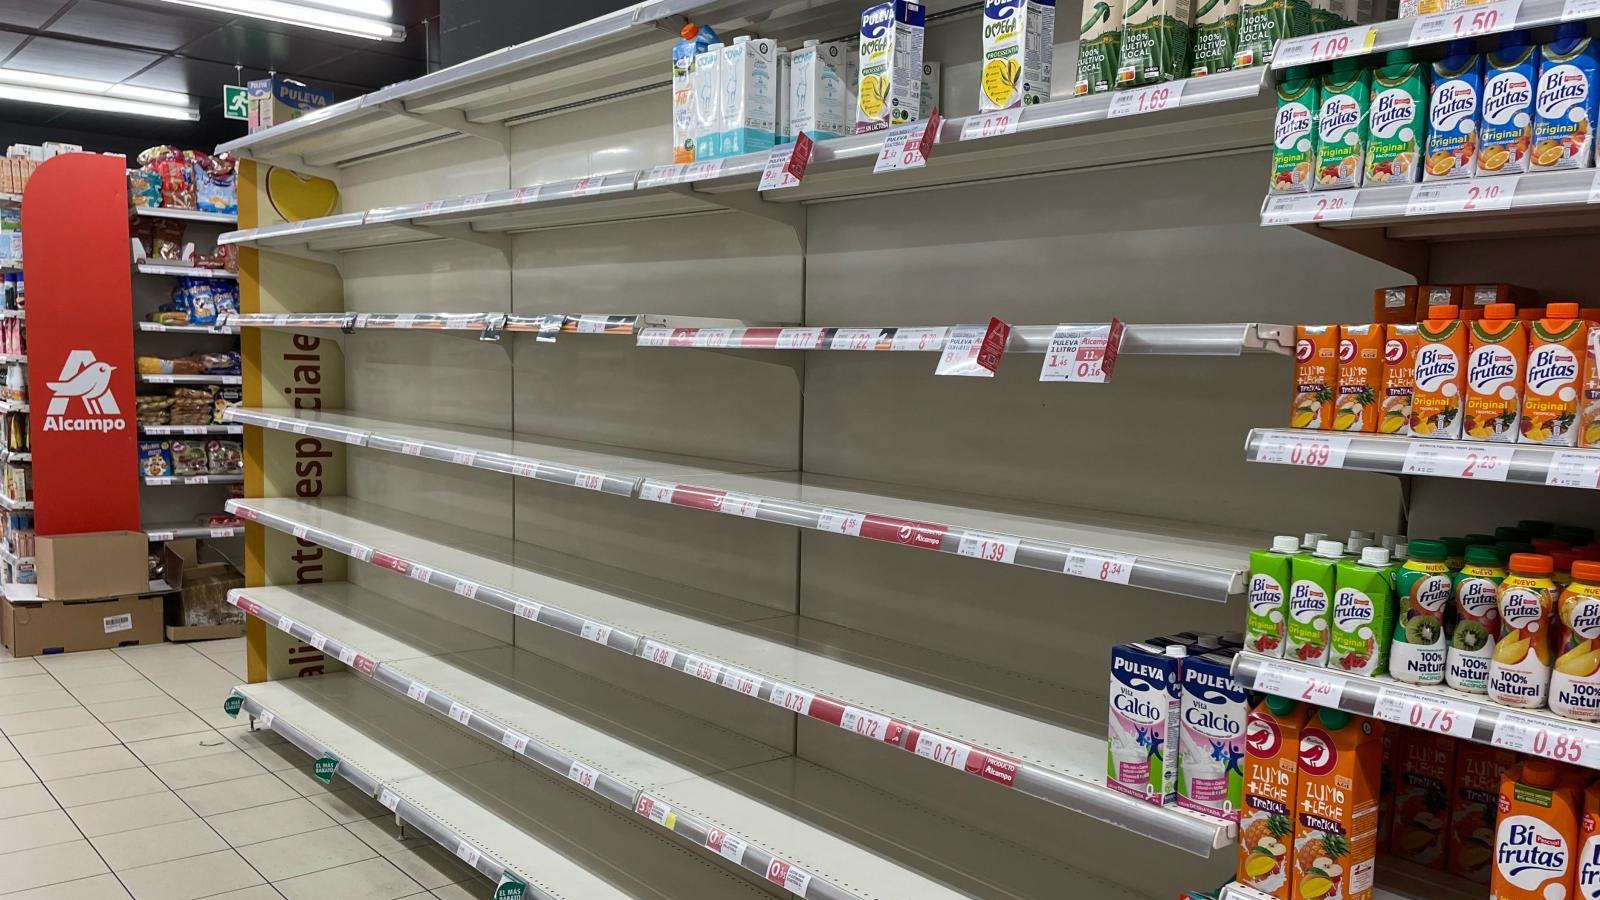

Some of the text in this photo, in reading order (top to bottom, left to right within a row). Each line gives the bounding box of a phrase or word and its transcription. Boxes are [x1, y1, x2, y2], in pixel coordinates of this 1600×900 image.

[984, 17, 1017, 38] OMEGA
[1244, 14, 1268, 24] 100%
[1453, 10, 1498, 36] 1.50
[1126, 32, 1148, 44] 100%
[1200, 32, 1221, 44] 100%
[1240, 32, 1269, 42] LOCAL
[1082, 48, 1099, 58] 100%
[1122, 48, 1150, 59] LOCAL
[1196, 49, 1222, 60] LOCAL
[1310, 36, 1349, 60] 1.09
[1078, 63, 1100, 72] LOCAL
[1492, 78, 1509, 97] Bi
[1546, 72, 1564, 90] Bi
[280, 86, 326, 106] PULEVA
[1138, 87, 1169, 112] 1.69
[1378, 94, 1394, 112] Bi
[1439, 86, 1454, 104] Bi
[1484, 90, 1529, 116] frutas
[1538, 84, 1585, 109] frutas
[1326, 100, 1340, 115] Bi
[1432, 97, 1474, 122] frutas
[1280, 108, 1293, 125] Bi
[1320, 110, 1358, 132] frutas
[1372, 106, 1412, 128] frutas
[1275, 118, 1309, 140] frutas
[1482, 128, 1522, 142] Original
[1535, 124, 1578, 137] Original
[886, 134, 908, 142] PULEVA
[1430, 134, 1468, 148] Original
[1318, 148, 1352, 158] Original
[1370, 142, 1406, 154] Original
[1464, 186, 1499, 210] 2.10
[1313, 198, 1344, 220] 2.20
[1422, 350, 1438, 366] Bi
[1478, 350, 1493, 367] Bi
[1536, 350, 1552, 367] Bi
[1078, 362, 1100, 378] 0,16
[1300, 366, 1326, 376] ZUMO
[1341, 366, 1368, 377] ZUMO
[1416, 362, 1456, 382] frutas
[1470, 363, 1514, 383] frutas
[1528, 362, 1574, 383] frutas
[1414, 398, 1449, 406] Original
[1468, 400, 1508, 410] Original
[1526, 401, 1568, 411] Original
[43, 416, 126, 433] Alcampo
[1290, 443, 1330, 466] 0.89
[1462, 453, 1498, 477] 2.25
[980, 541, 1005, 562] 1.39
[1100, 560, 1122, 580] 8.34
[1253, 578, 1265, 592] Bi
[1429, 580, 1442, 592] Bi
[1468, 584, 1482, 595] Bi
[1513, 578, 1536, 587] NUEVO
[1296, 585, 1308, 598] Bi
[1340, 592, 1352, 606] Bi
[1290, 597, 1326, 610] frutas
[1509, 594, 1524, 607] Bi
[1334, 605, 1372, 618] frutas
[1504, 604, 1540, 617] frutas
[1583, 604, 1599, 617] Bi
[1420, 652, 1442, 662] 100%
[1462, 658, 1488, 670] 100%
[1114, 656, 1164, 682] PULEVA
[1500, 671, 1528, 684] 100%
[1186, 668, 1244, 694] PULEVA
[1302, 678, 1332, 700] 2.20
[1490, 678, 1540, 697] Natural
[784, 692, 804, 712] 0.73
[1114, 694, 1160, 720] Calcio
[856, 716, 878, 738] 0.72
[1186, 708, 1240, 734] Calcio
[1410, 703, 1454, 734] 0.75
[1533, 729, 1584, 762] 0.85
[934, 743, 958, 766] 0.71
[984, 765, 1012, 782] Alcampo
[986, 758, 1015, 772] PRODUCTO
[1252, 764, 1290, 786] ZUMO
[1247, 781, 1288, 802] +LECHE
[1306, 782, 1344, 804] ZUMO
[1301, 800, 1344, 821] +LECHE
[1509, 824, 1561, 846] Bi Pascual
[1498, 842, 1564, 868] frutas
